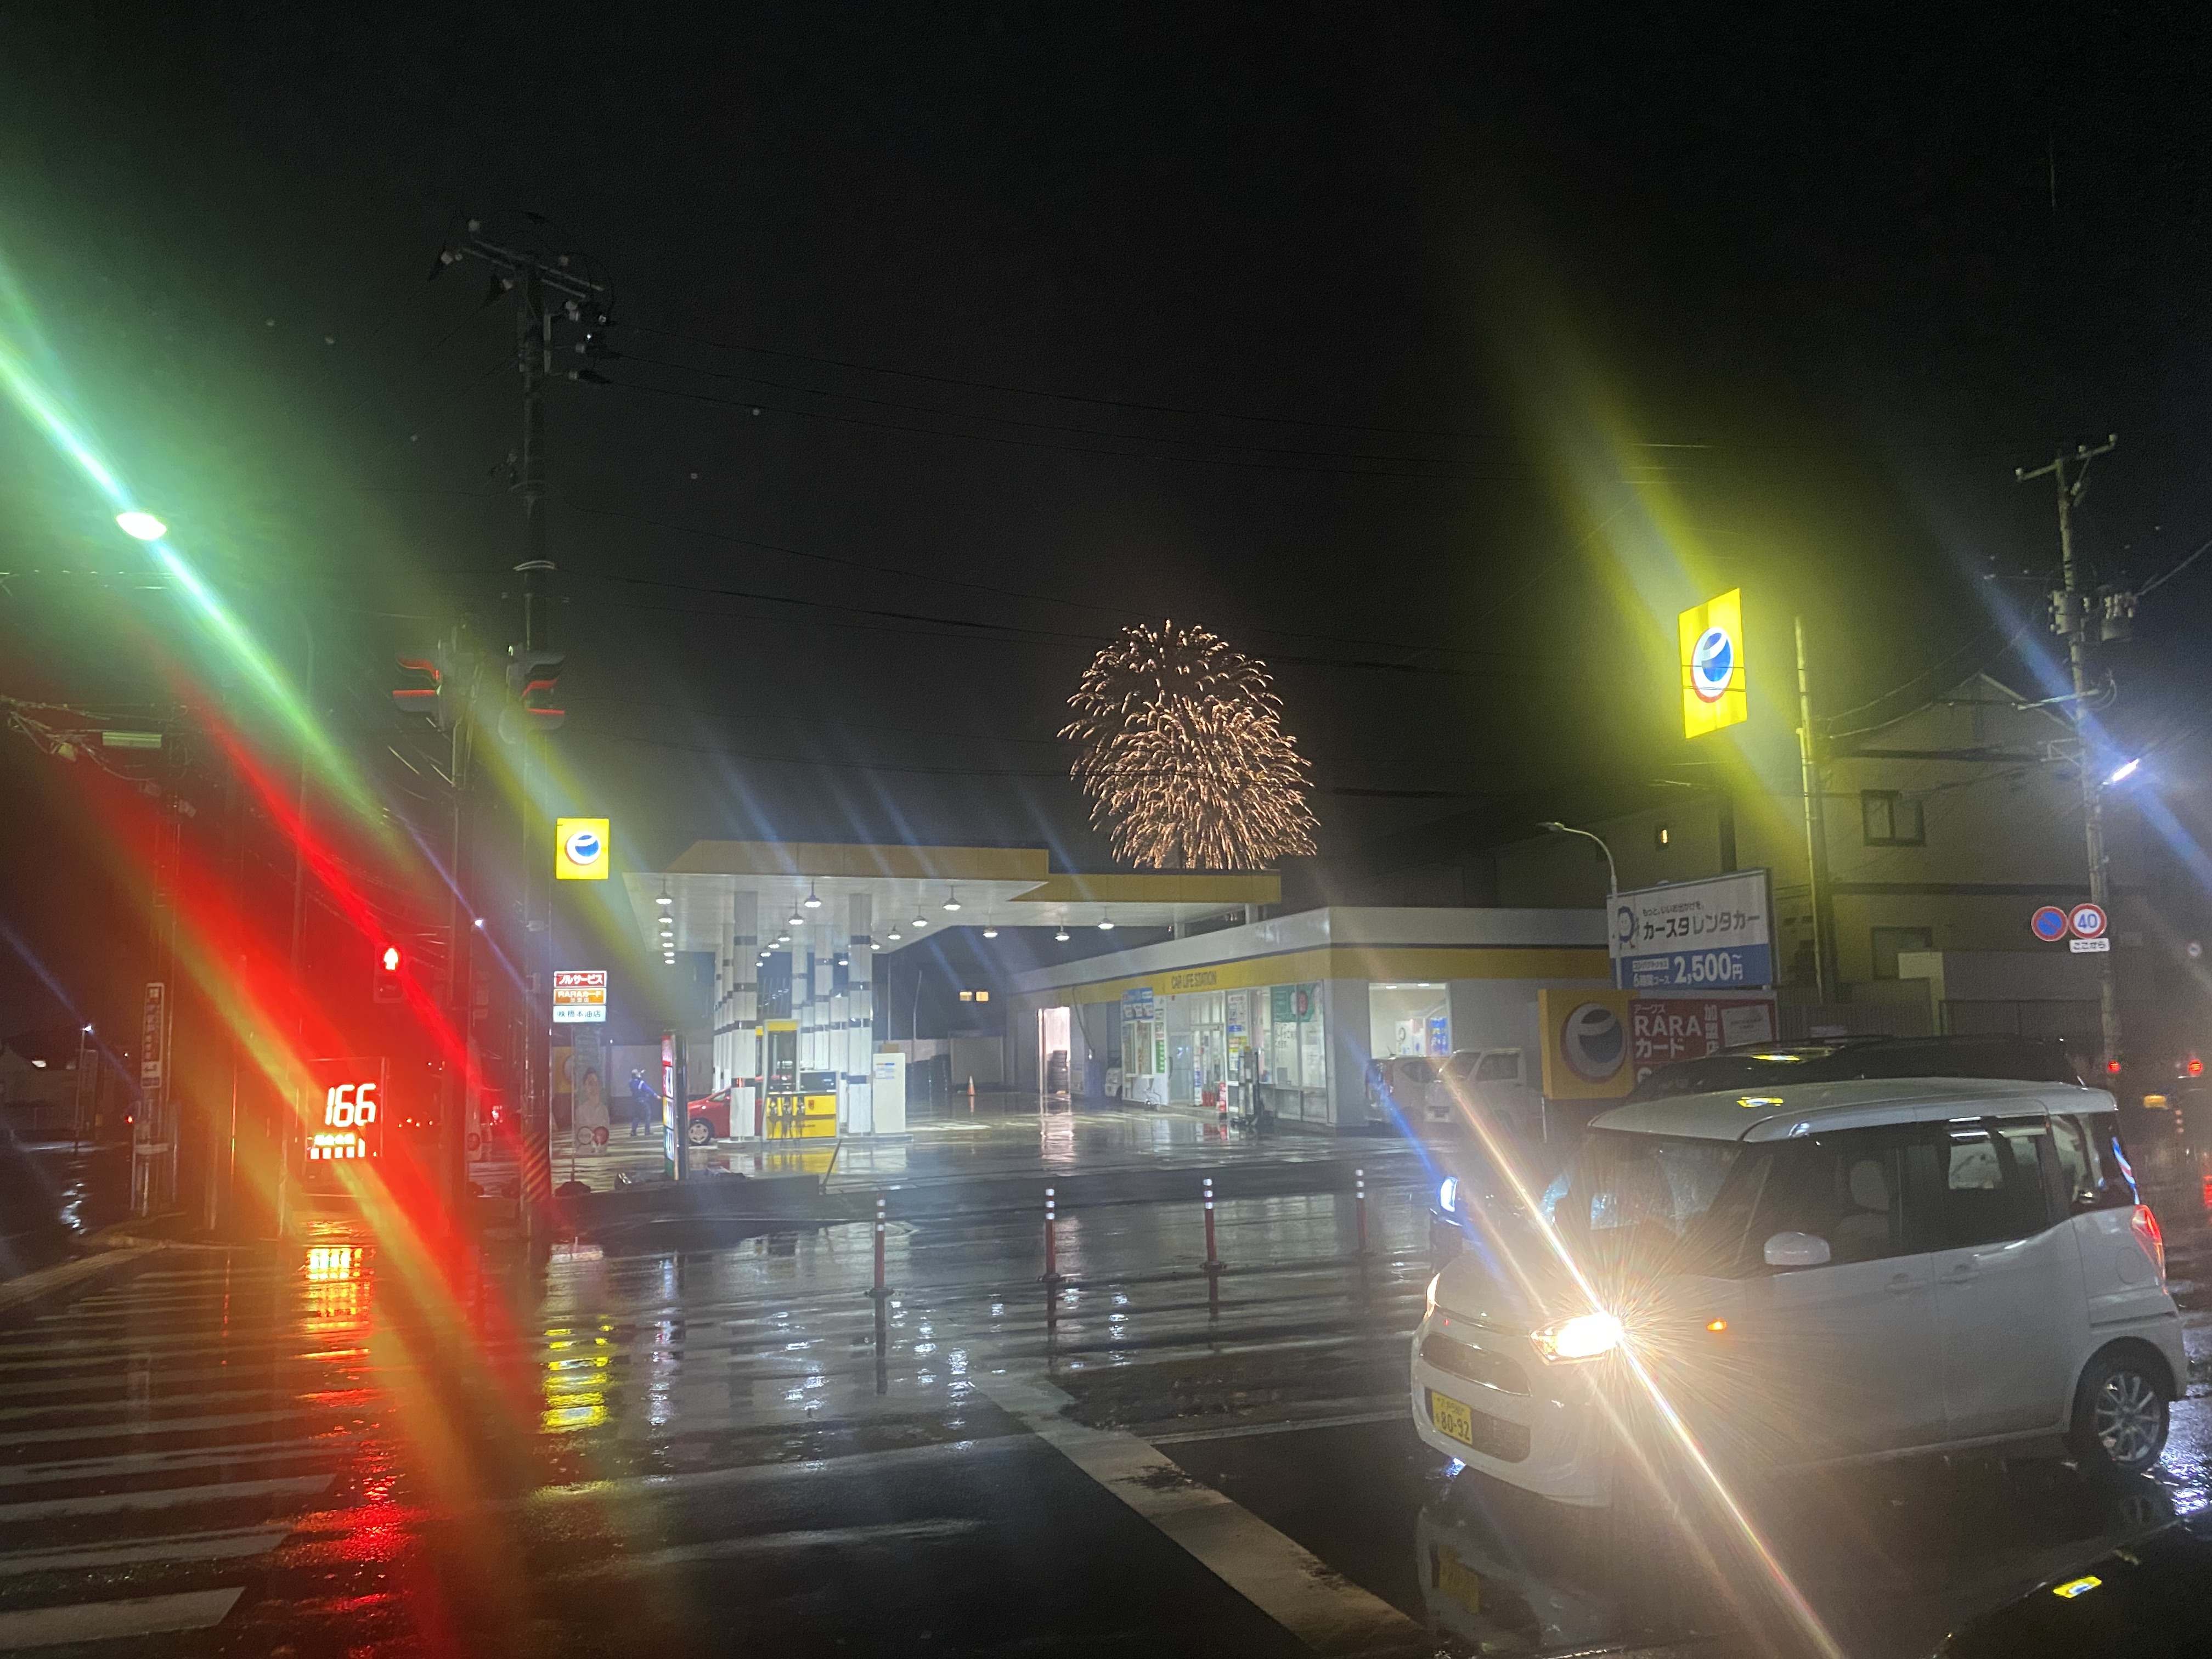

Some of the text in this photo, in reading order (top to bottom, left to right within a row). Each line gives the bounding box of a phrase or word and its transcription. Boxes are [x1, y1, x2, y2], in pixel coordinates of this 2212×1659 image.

[1643, 910, 1760, 940] カースタレンタカー
[2078, 913, 2097, 928] 40
[558, 974, 603, 985] フルサービス
[1171, 970, 1217, 989] CAR LIFE STATION
[1634, 1003, 1666, 1014] アークス
[1634, 1015, 1702, 1036] RARA
[1635, 1037, 1685, 1058] カード
[324, 1082, 377, 1127] 166
